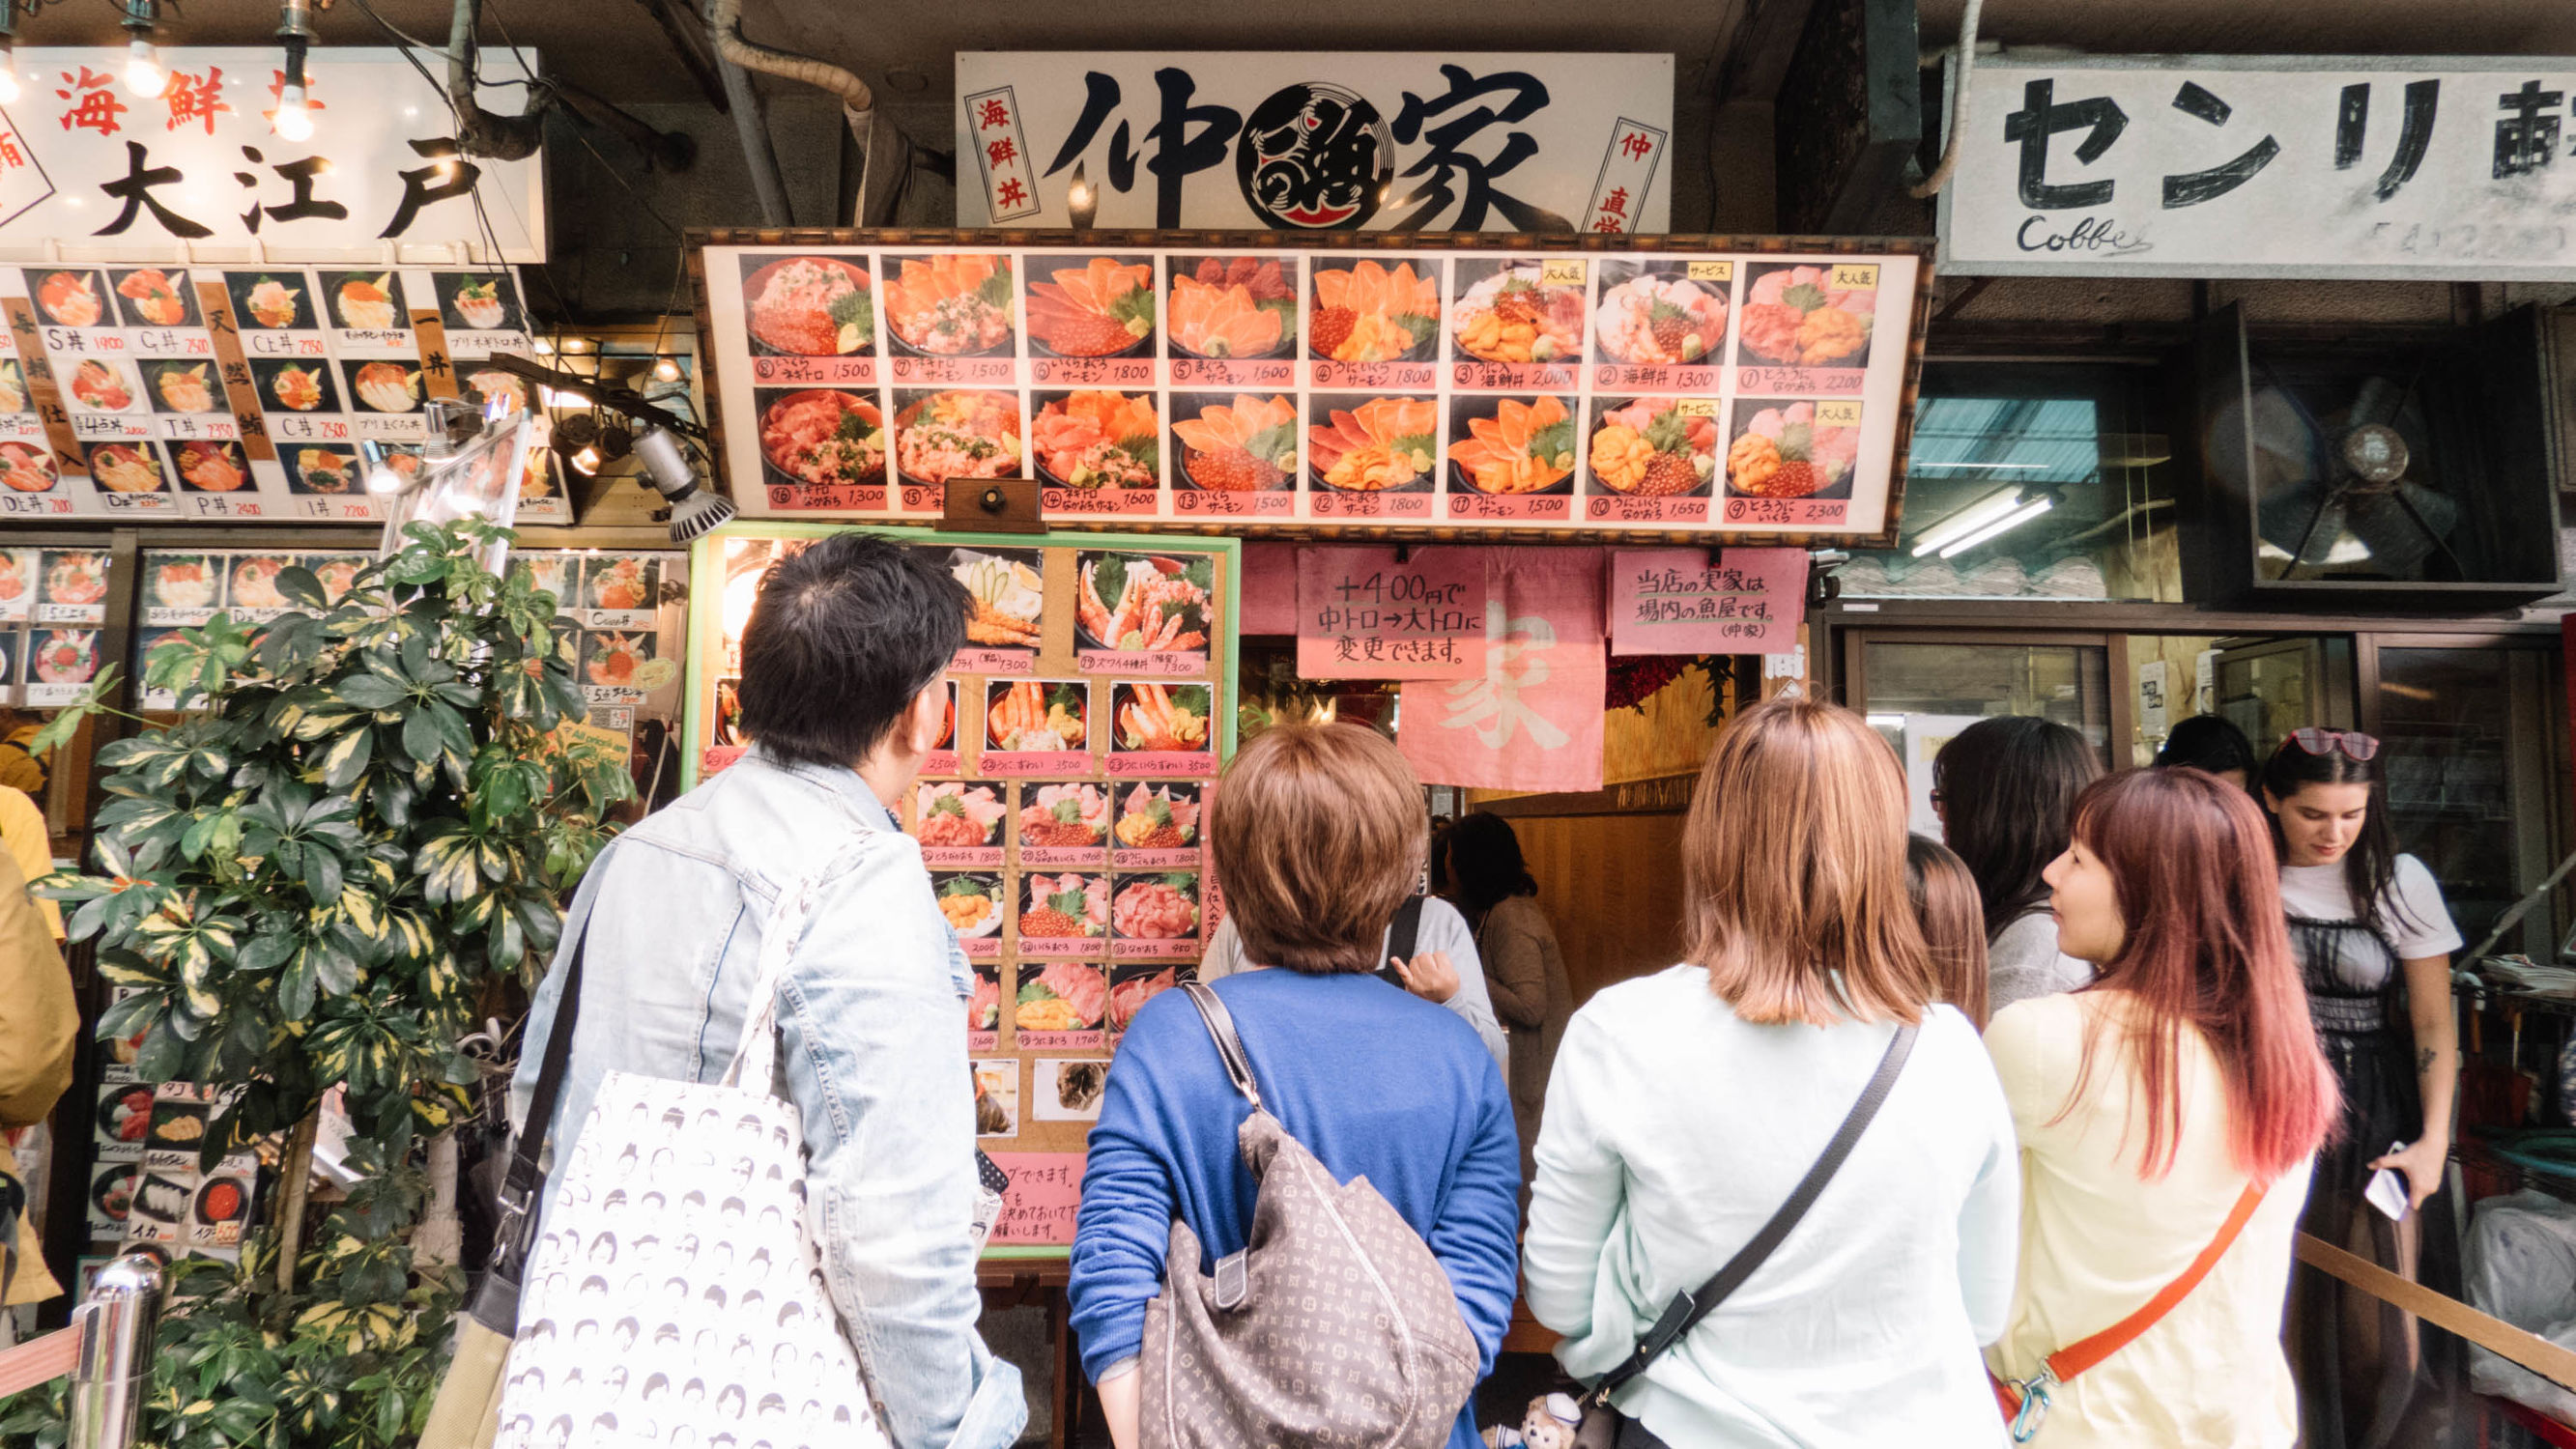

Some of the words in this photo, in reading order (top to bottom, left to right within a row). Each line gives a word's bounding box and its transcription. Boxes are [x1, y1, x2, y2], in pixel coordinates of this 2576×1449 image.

[977, 99, 1028, 210] 海鮮丼
[1043, 68, 1243, 230] 仲
[1391, 65, 1578, 232] 家
[1620, 132, 1652, 162] 仲
[92, 140, 481, 239] 大江戸
[1545, 267, 1580, 281] 大人気
[1691, 266, 1725, 277] サービス
[1837, 270, 1872, 285] 大人気
[776, 358, 810, 371] いくら
[833, 363, 871, 380] 1,500
[914, 357, 956, 369] ネギトロ
[1195, 360, 1228, 374] まぐろ
[782, 370, 824, 380] ネギトロ
[925, 371, 966, 382] サーモン
[1062, 371, 1102, 383] サーモン
[1113, 364, 1149, 382] 1,800
[1205, 373, 1246, 385] サーモン
[1347, 375, 1388, 386] サーモン
[1480, 373, 1524, 388] 海鮮丼
[1532, 369, 1573, 387] 2,000
[1623, 368, 1669, 386] 海鮮丼
[1676, 371, 1714, 389] 1,300
[1681, 403, 1716, 415] サービス
[1819, 408, 1855, 421] 大人気
[793, 484, 830, 495] ネギトロ
[849, 490, 884, 505] 1,300
[1064, 488, 1098, 499] ネギトロ
[1124, 494, 1156, 508] 1,600
[1199, 491, 1229, 502] いくら
[1207, 501, 1245, 514] サーモン
[1344, 503, 1380, 515] サーモン
[1474, 494, 1496, 505] うに
[1528, 498, 1563, 515] 1,500
[1478, 505, 1515, 517] サーモン
[1670, 501, 1706, 519] 1,650
[1804, 503, 1845, 521] 2,300
[1759, 513, 1791, 523] いくら
[1635, 597, 1774, 622] 場内の魚屋です。
[1333, 635, 1463, 665] 変更できます。
[1440, 600, 1571, 750] 家
[194, 1228, 217, 1239] イク
